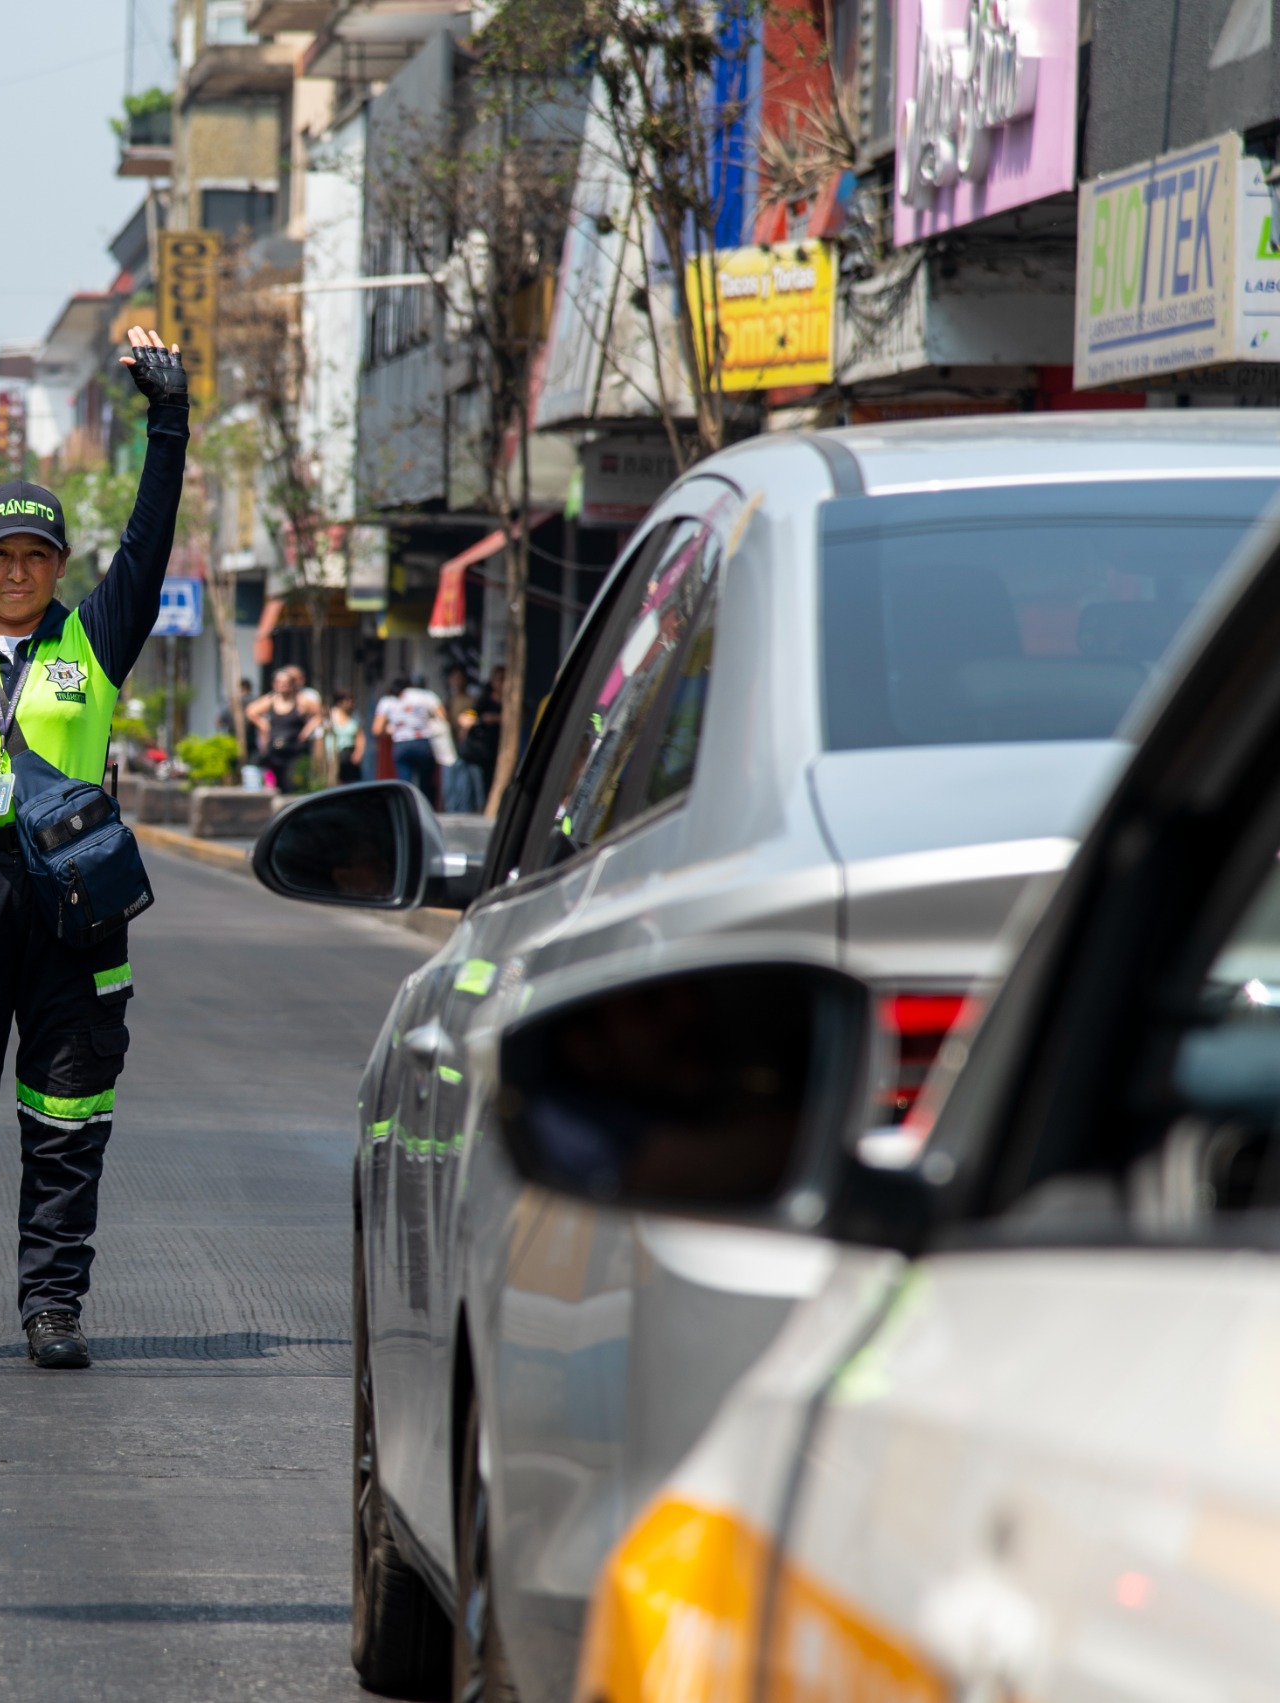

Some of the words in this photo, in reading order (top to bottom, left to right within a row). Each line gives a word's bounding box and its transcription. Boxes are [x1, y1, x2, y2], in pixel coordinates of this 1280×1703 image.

[1089, 158, 1219, 318] BIOTTEK
[720, 271, 758, 298] Tacos
[761, 273, 769, 300] y
[772, 265, 816, 293] Tortas
[123, 890, 150, 918] K-SWISS
